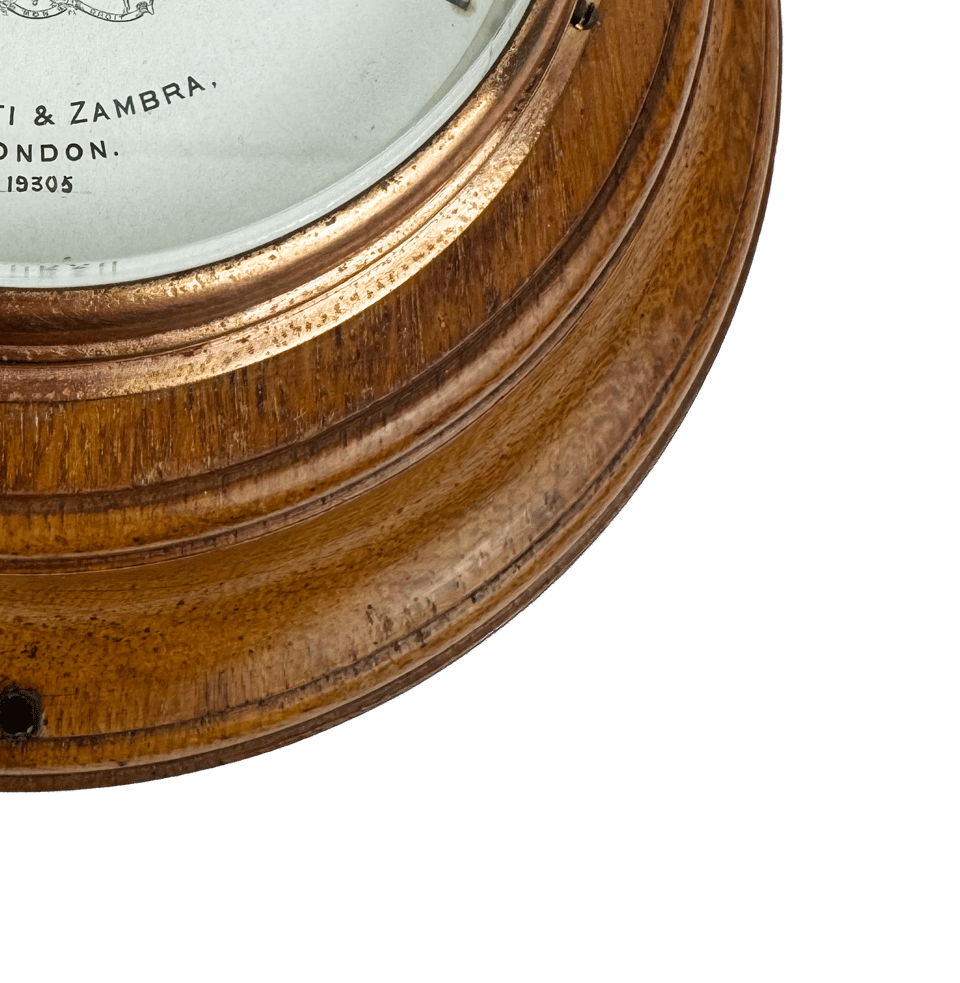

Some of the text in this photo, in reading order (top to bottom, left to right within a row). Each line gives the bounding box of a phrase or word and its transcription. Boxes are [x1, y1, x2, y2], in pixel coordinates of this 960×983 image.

[34, 105, 56, 126] &
[70, 75, 218, 125] ZAMBRA,
[6, 174, 74, 194] 19305
